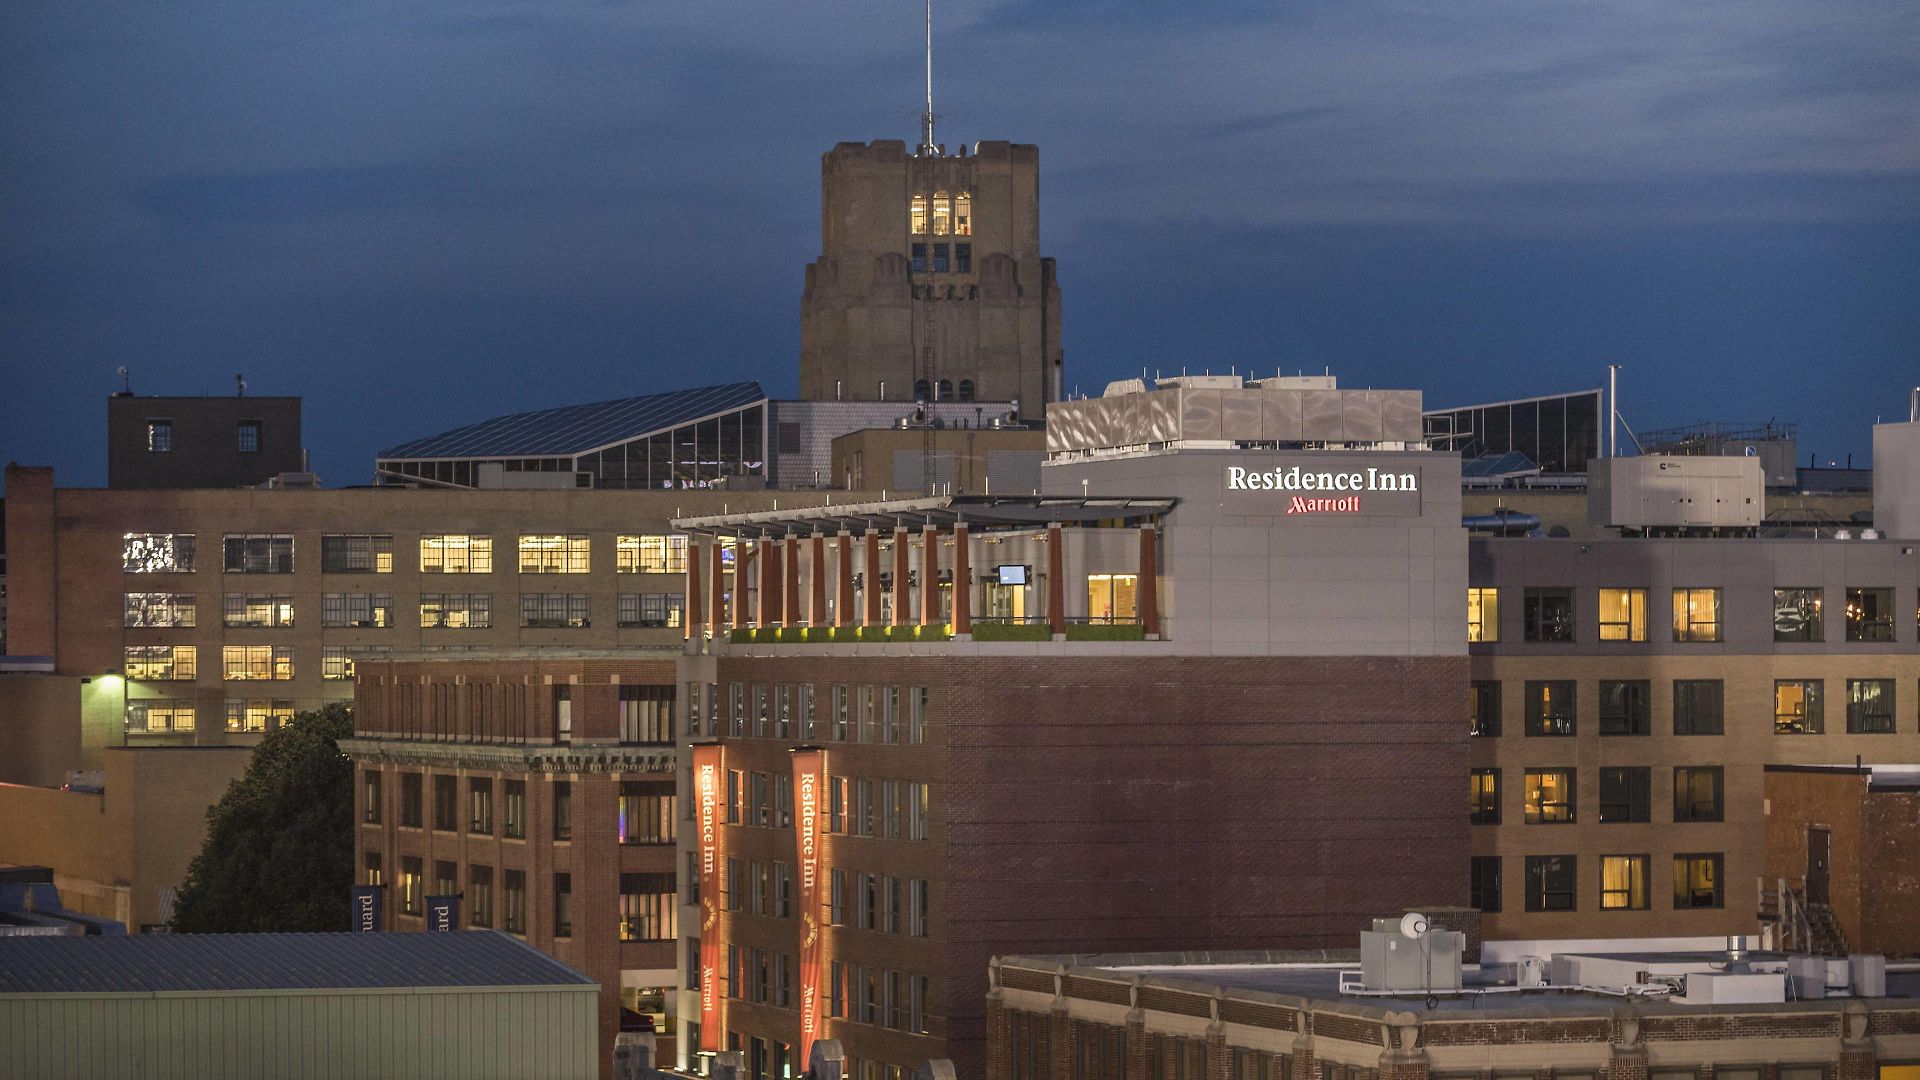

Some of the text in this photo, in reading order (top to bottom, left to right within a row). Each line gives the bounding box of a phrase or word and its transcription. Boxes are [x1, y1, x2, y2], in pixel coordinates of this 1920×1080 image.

[1228, 466, 1418, 491] Residence Inn
[1287, 495, 1360, 514] Marriott
[701, 763, 715, 874] Residence Inn
[801, 772, 817, 888] Residence Inn
[703, 964, 713, 1011] Marriott
[803, 983, 814, 1033] Marriott
